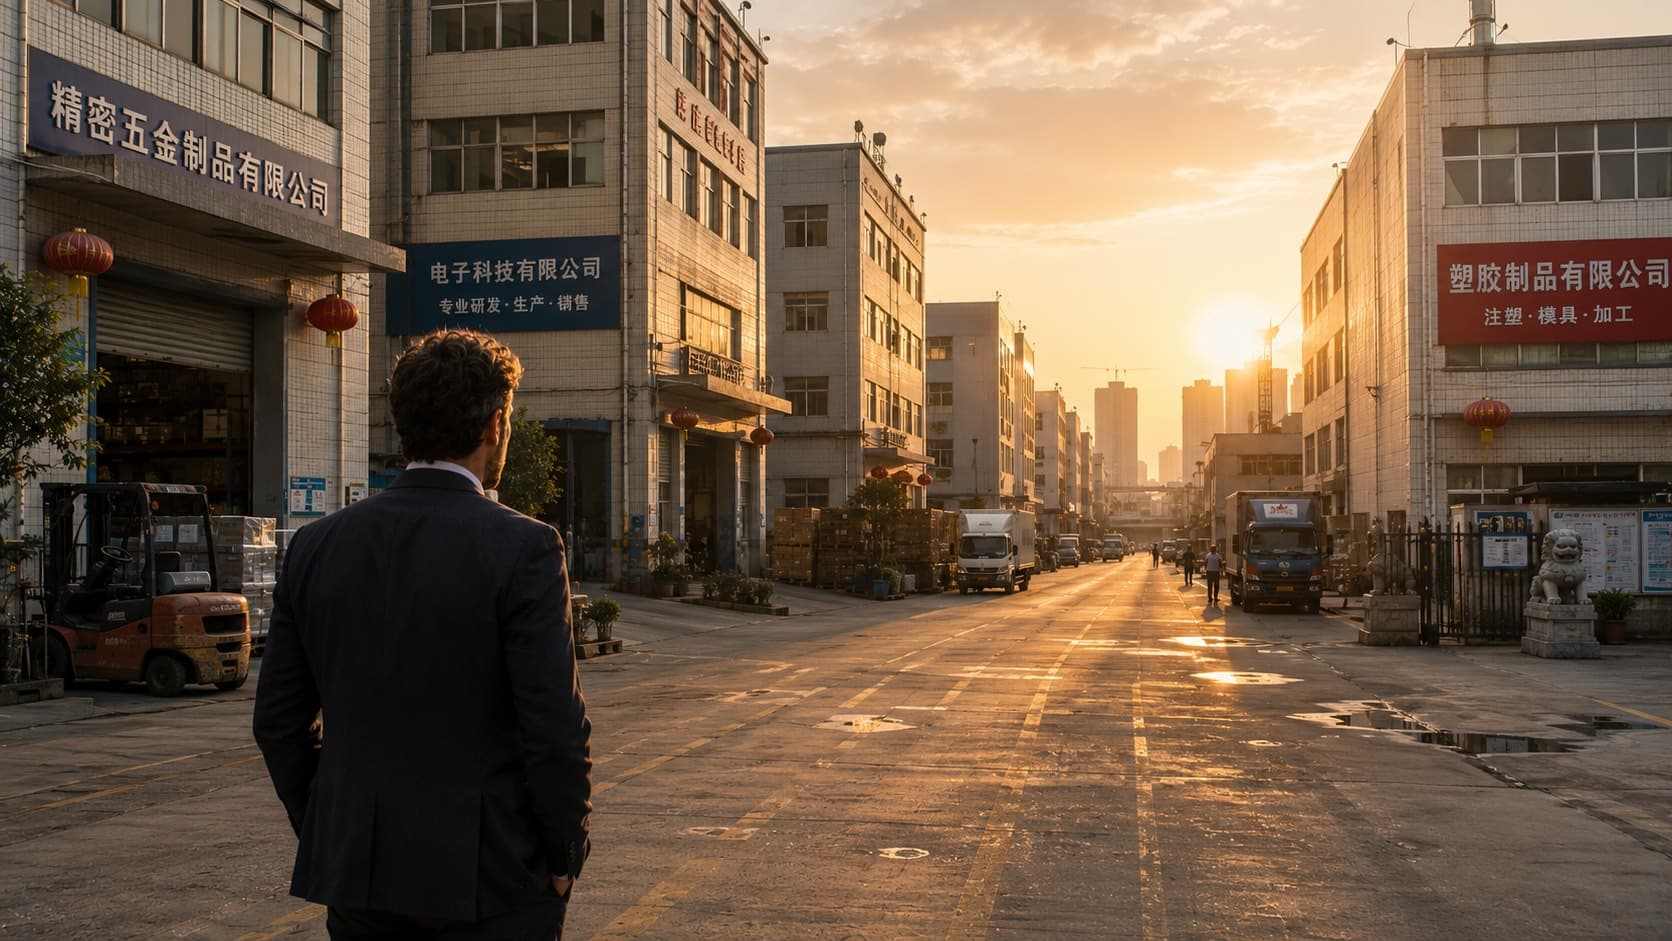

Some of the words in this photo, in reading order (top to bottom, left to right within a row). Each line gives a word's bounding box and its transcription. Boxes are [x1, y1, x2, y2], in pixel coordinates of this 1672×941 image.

[51, 80, 329, 216] 精密五金制品有限公司
[430, 256, 601, 285] 电子科技有限公司
[1449, 258, 1670, 294] 塑胶制品有限公司
